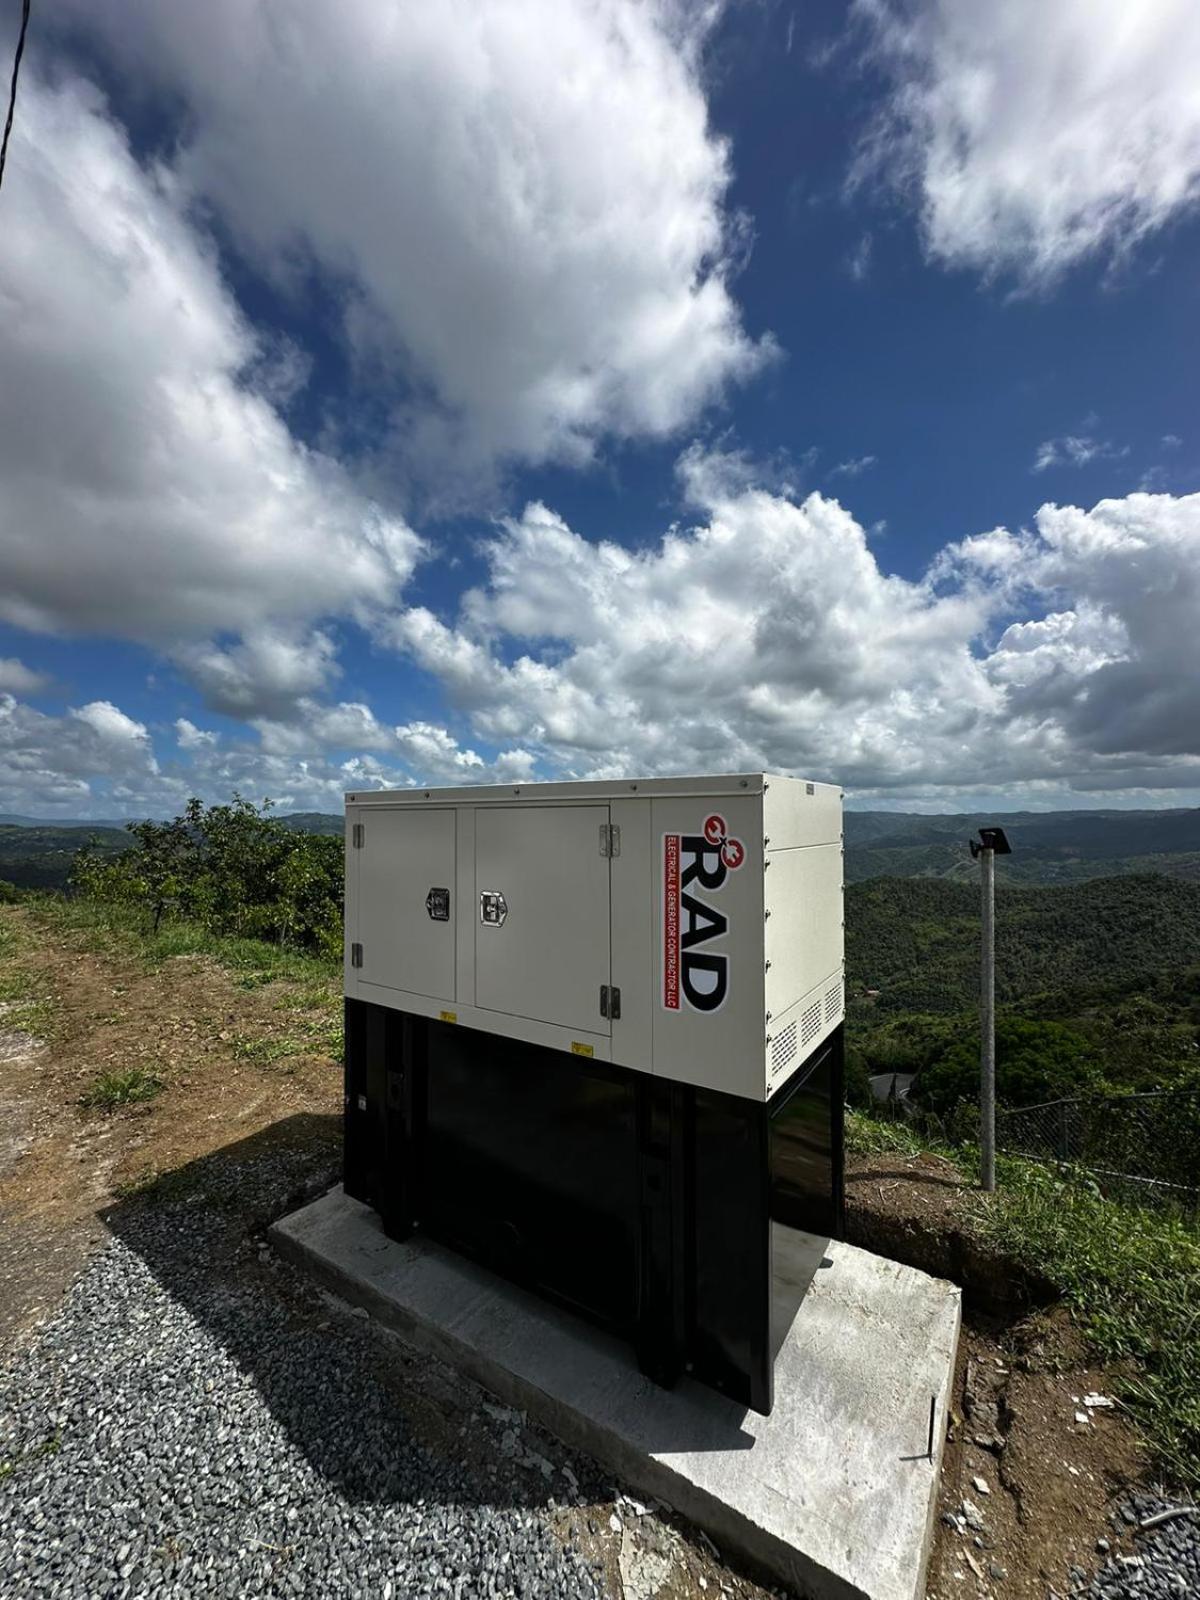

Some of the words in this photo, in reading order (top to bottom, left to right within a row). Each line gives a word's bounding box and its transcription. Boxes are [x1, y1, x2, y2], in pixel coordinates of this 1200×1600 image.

[667, 836, 676, 882] ELECTRICAL
[667, 891, 676, 937] GENERATOR
[681, 836, 728, 1011] RAD
[667, 938, 676, 990] CONTRACTOR
[667, 991, 676, 1007] LLC
